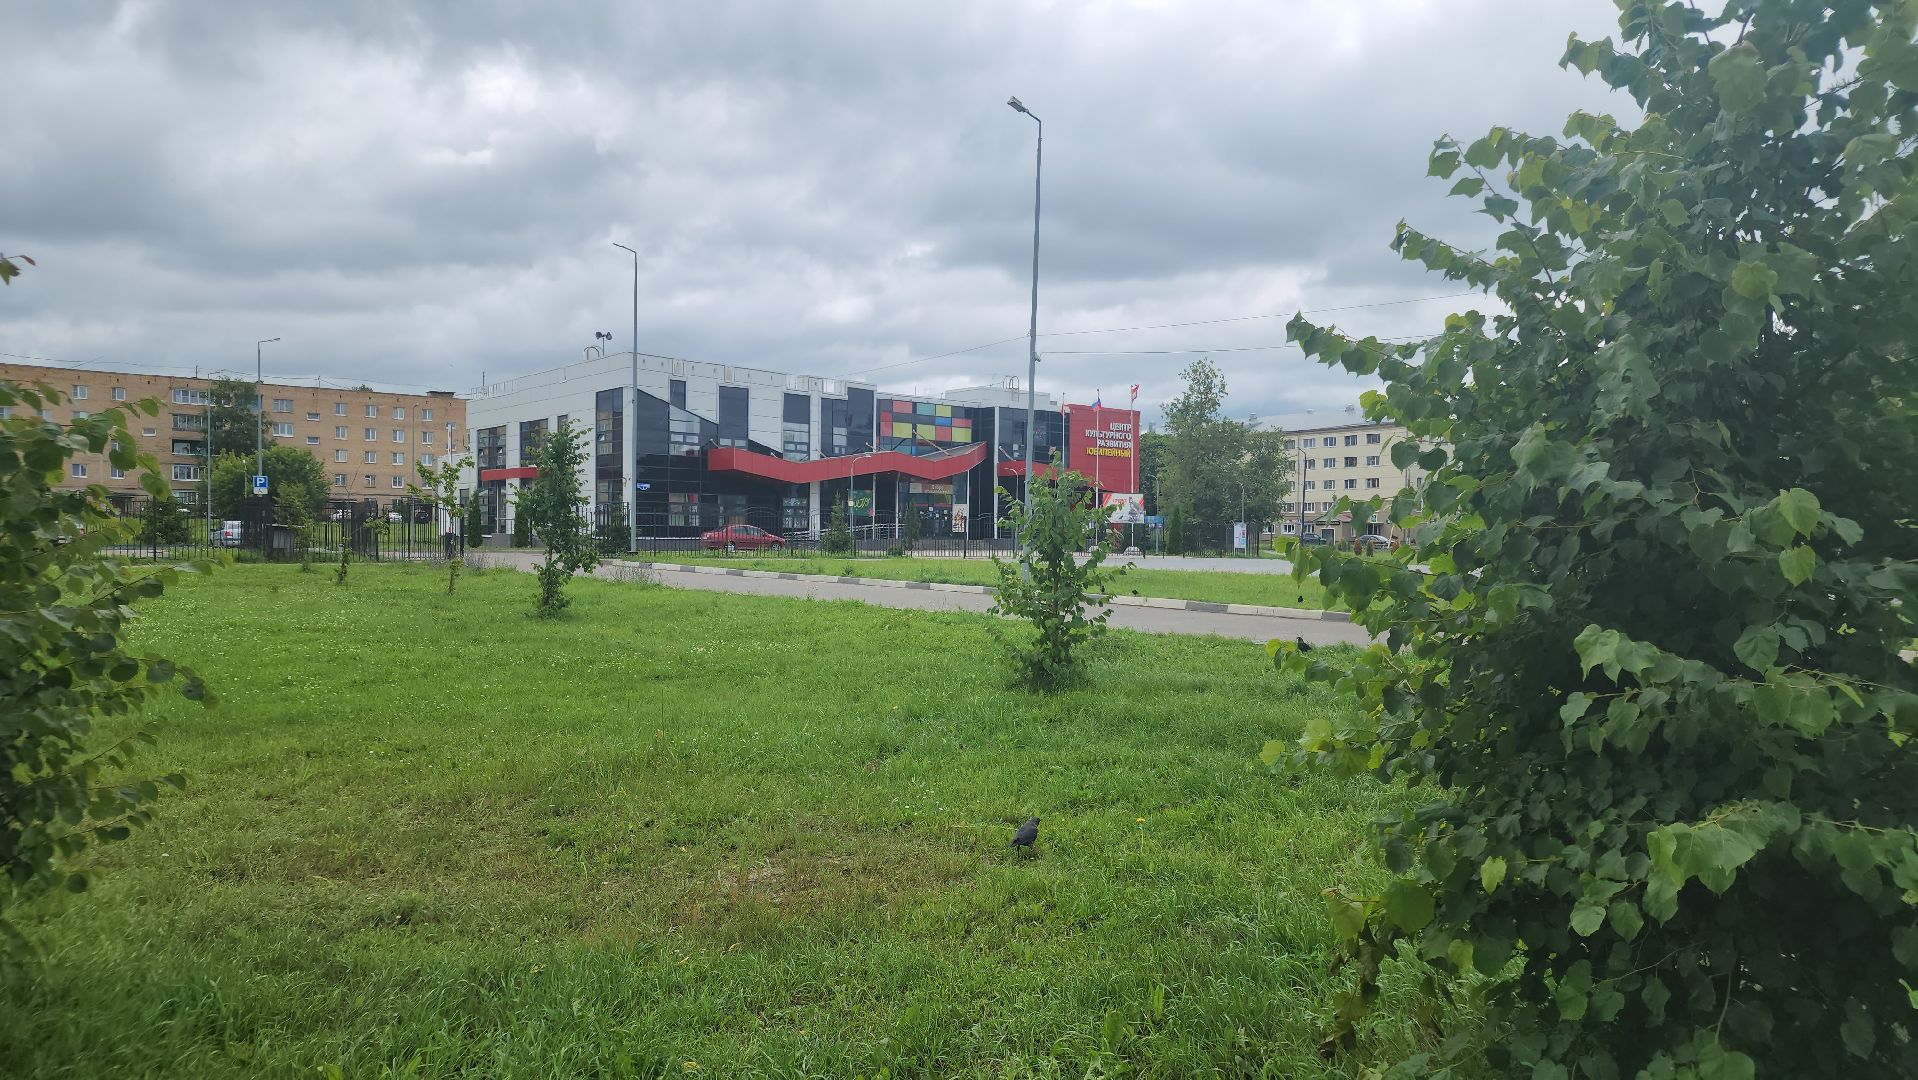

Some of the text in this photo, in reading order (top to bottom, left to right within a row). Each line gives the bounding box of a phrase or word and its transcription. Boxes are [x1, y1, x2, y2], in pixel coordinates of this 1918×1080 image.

[1110, 422, 1132, 431] ЦЕНТР
[1085, 429, 1132, 440] КУЛЬТУРНОГО
[1097, 439, 1131, 448] РАЗВИТИЯ
[1086, 447, 1131, 458] ЮБИЛЕЙНЫЙ
[256, 477, 265, 487] P
